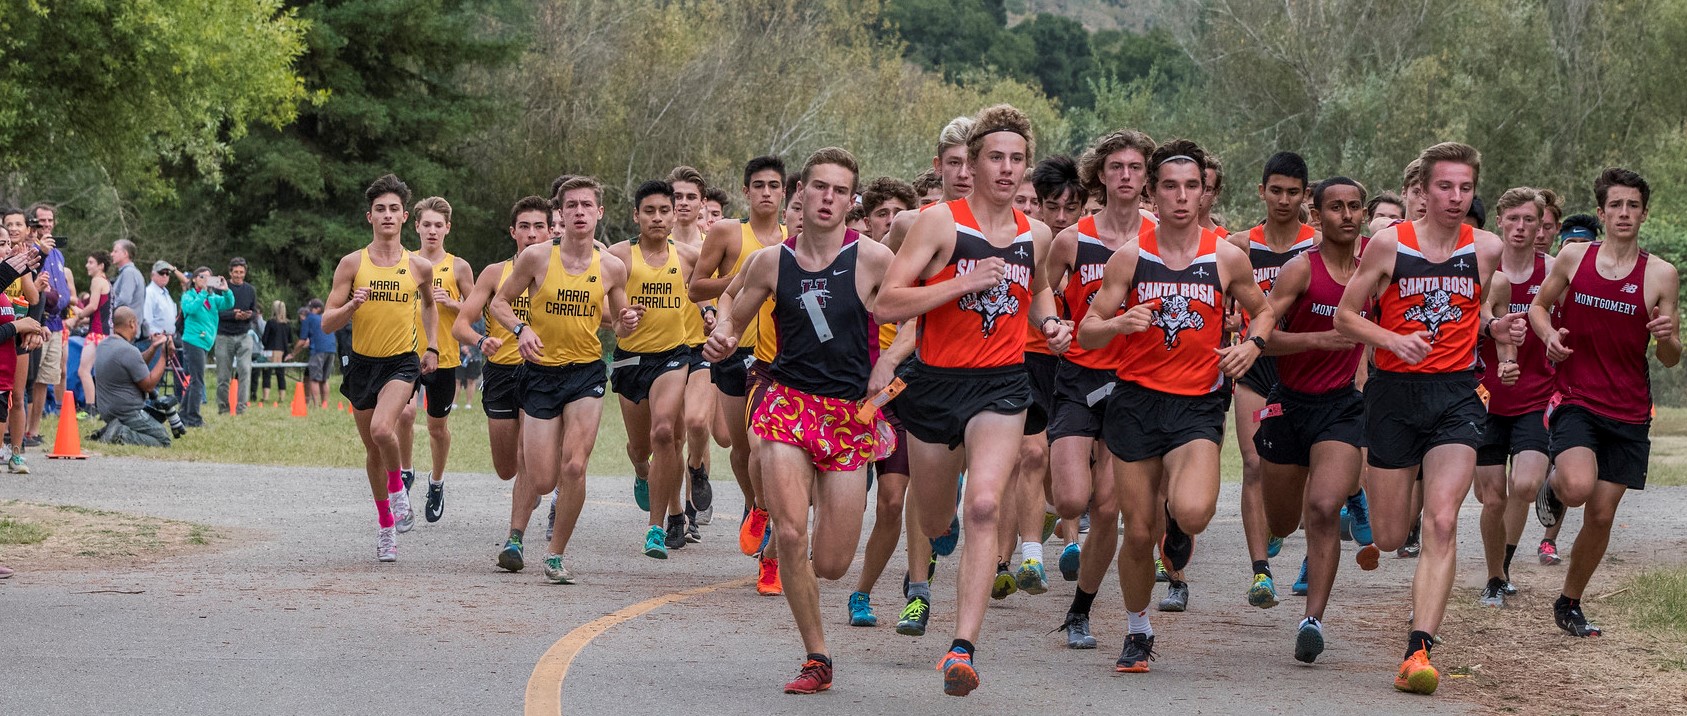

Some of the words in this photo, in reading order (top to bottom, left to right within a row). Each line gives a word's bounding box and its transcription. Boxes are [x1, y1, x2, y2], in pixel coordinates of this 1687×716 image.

[1080, 264, 1105, 285] SAN
[369, 280, 400, 291] MARIA
[642, 282, 672, 295] MARIA
[1137, 282, 1177, 303] SANTA
[1181, 283, 1215, 307] ROSA
[1399, 277, 1440, 298] SANTA
[1442, 277, 1474, 300] ROSA
[557, 288, 590, 303] MARIA
[1574, 292, 1637, 315] MONTGOMERY
[545, 301, 596, 317] CARRILLO
